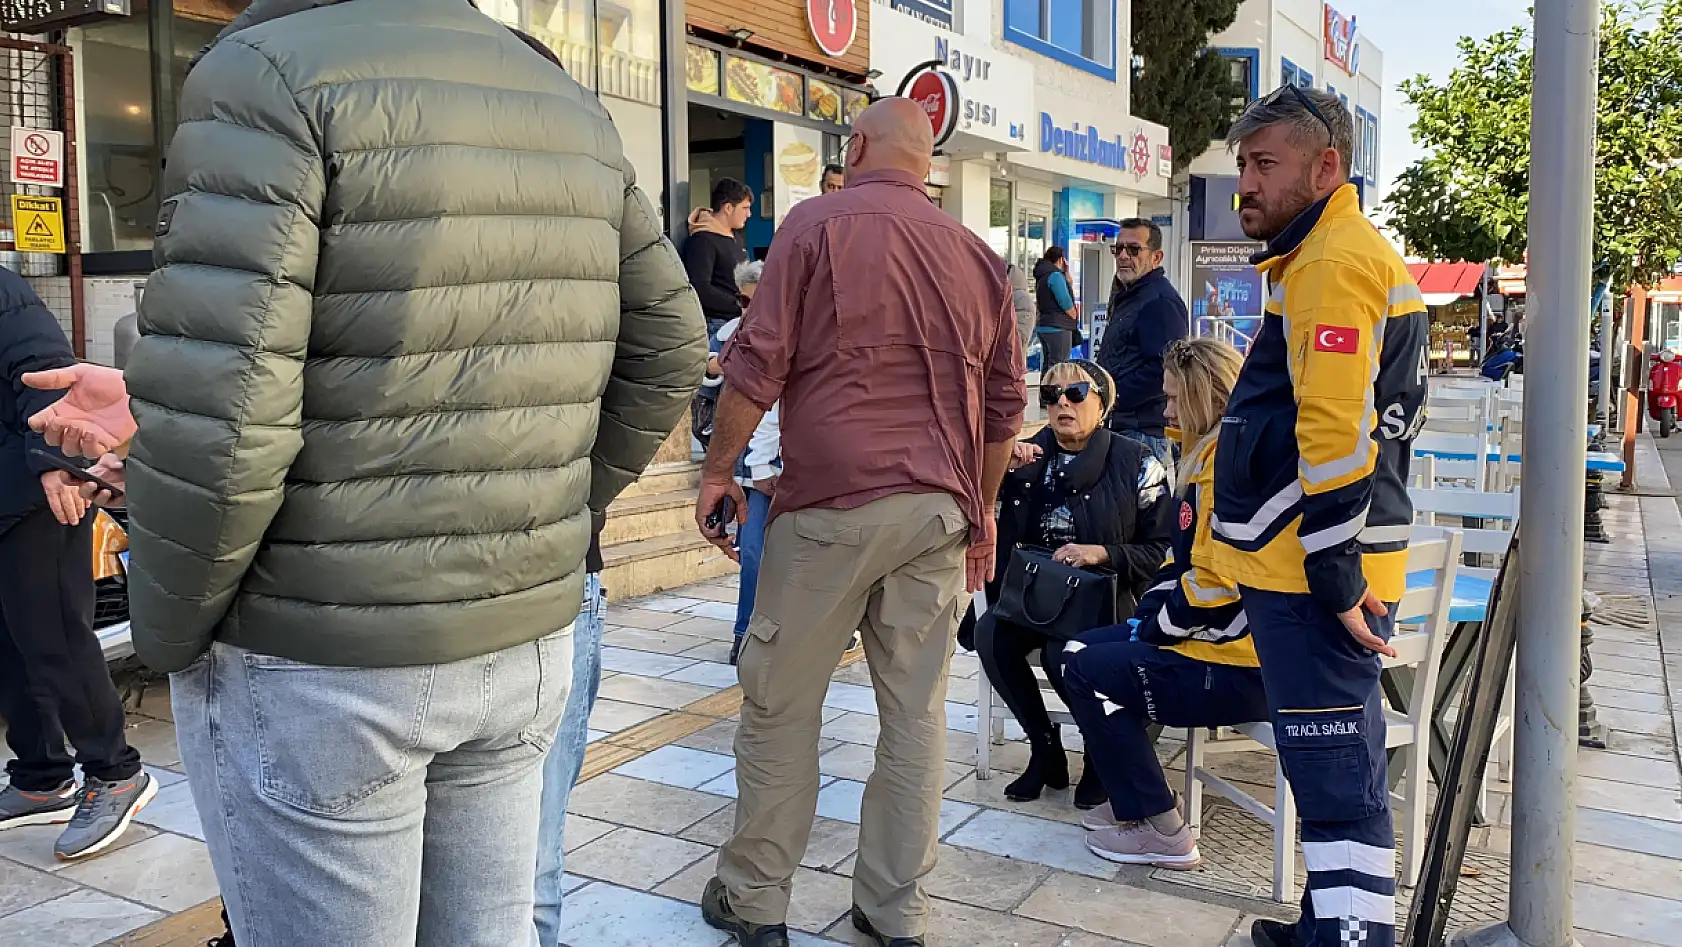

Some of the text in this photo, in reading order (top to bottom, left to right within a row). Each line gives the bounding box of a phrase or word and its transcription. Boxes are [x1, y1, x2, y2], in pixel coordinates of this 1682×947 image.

[935, 36, 991, 82] Nayır
[1040, 112, 1126, 170] DenizBank
[1201, 245, 1226, 254] Prime
[1285, 725, 1301, 737] 112
[1322, 720, 1359, 736] SAĞLIK
